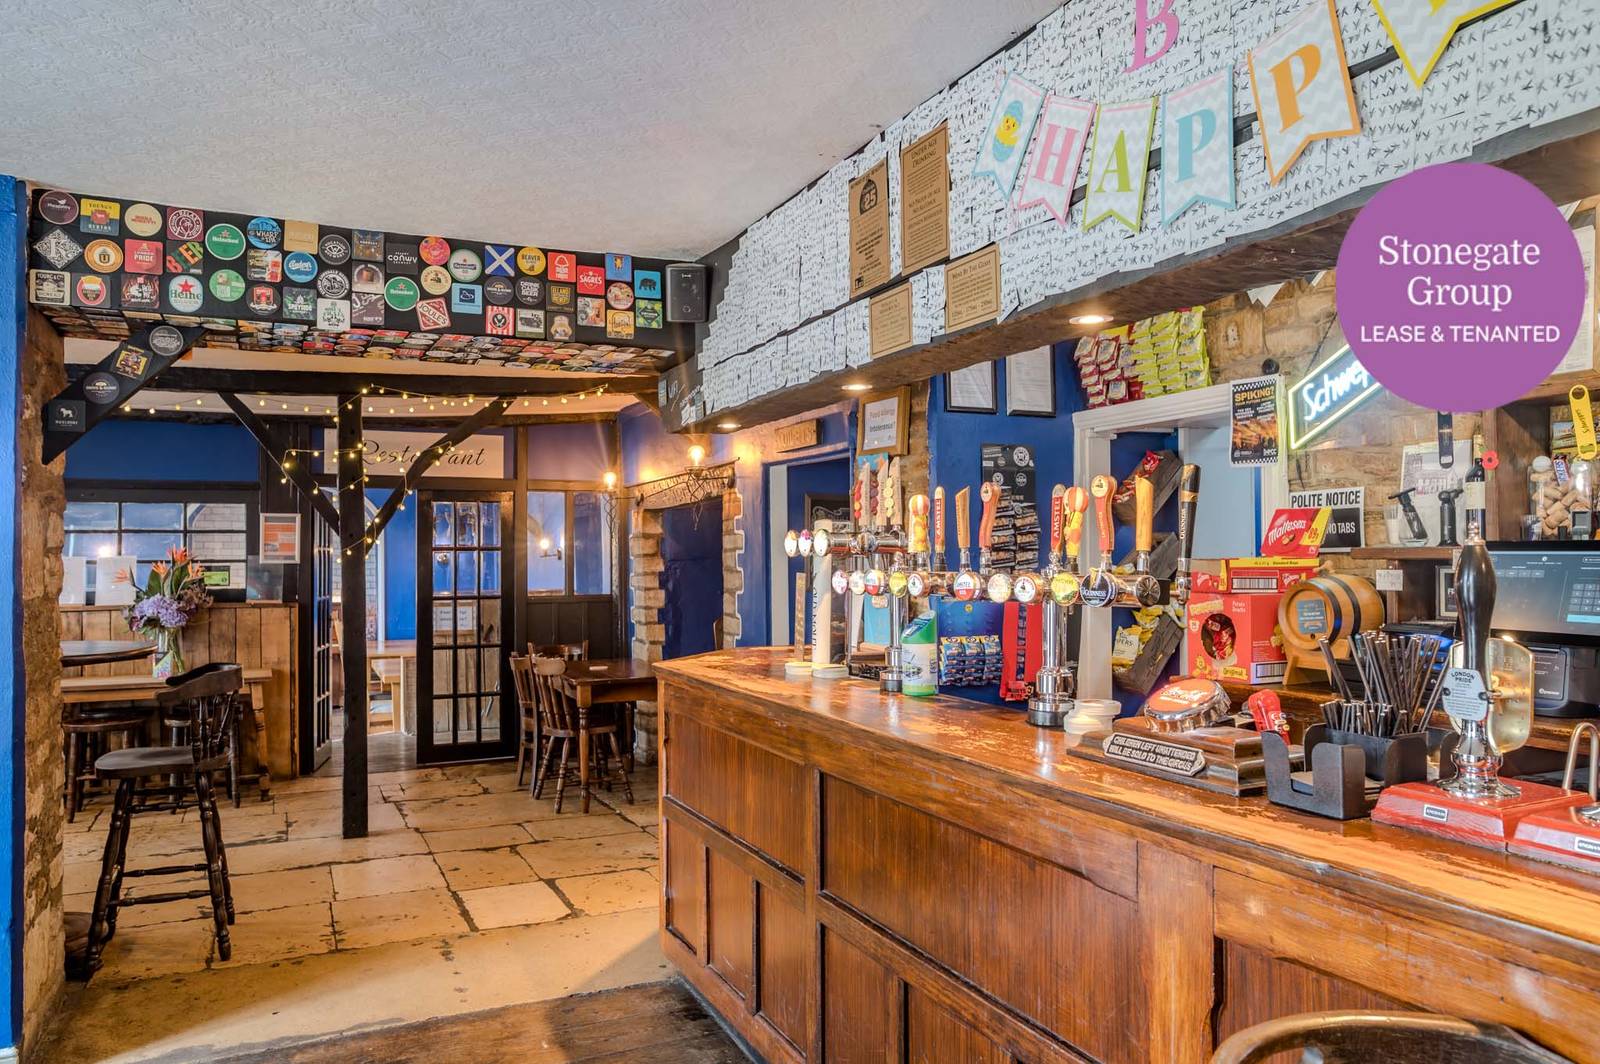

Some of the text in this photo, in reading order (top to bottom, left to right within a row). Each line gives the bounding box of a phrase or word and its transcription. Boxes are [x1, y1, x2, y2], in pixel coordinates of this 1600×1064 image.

[1122, 0, 1180, 73] B
[134, 254, 153, 263] PRIDE
[580, 275, 602, 285] SAGRES
[419, 303, 448, 326] JOULE'S
[1234, 386, 1275, 402] SPIKING?
[1291, 490, 1361, 508] POLITE NOTICE
[1054, 497, 1062, 538] AMSTEL
[1268, 519, 1307, 546] Maltesers
[1338, 521, 1356, 534] TABS
[1085, 589, 1107, 598] GUINNESS
[1451, 672, 1475, 680] LONDON
[1113, 736, 1197, 761] CHILDREN LEFT UNATTENDED
[1108, 744, 1123, 755] WILL
[1131, 749, 1147, 760] SOLD
[1155, 755, 1169, 765] THE
[1168, 758, 1193, 772] CIRCUS
